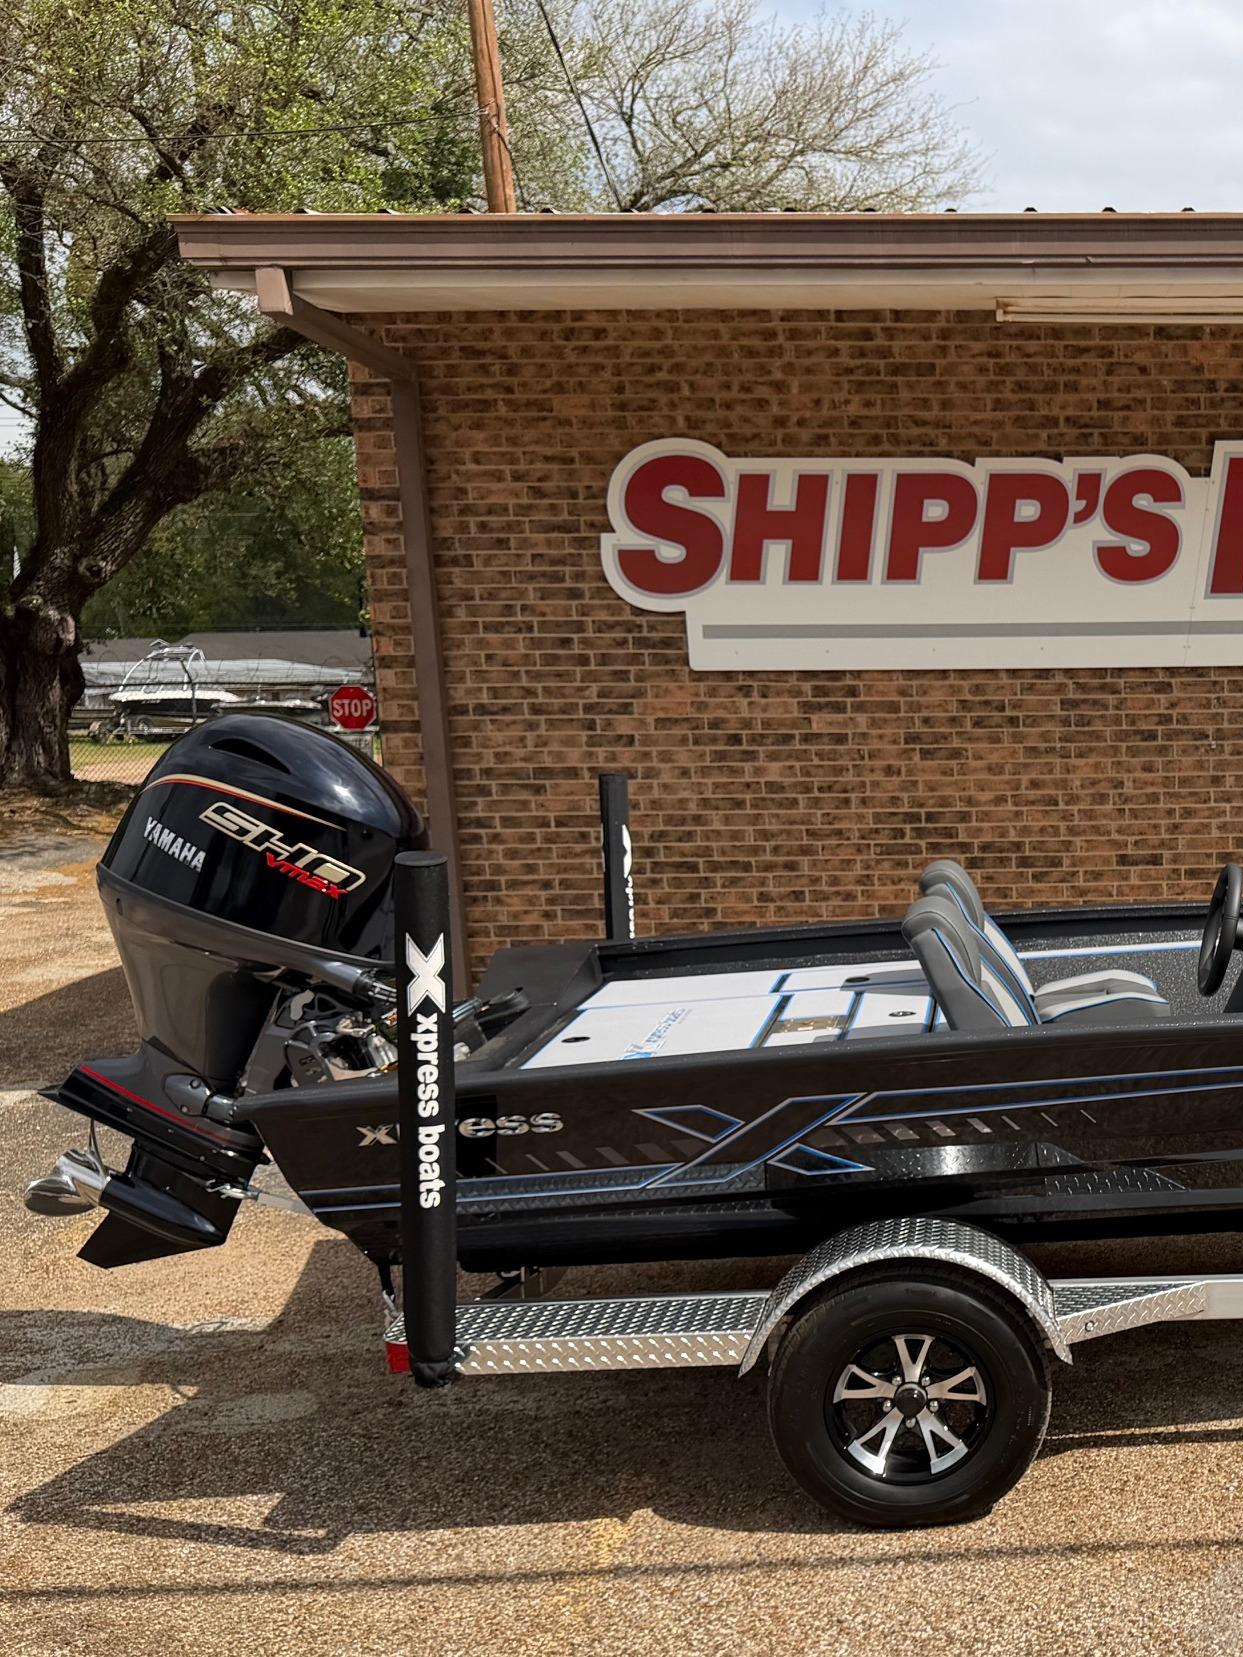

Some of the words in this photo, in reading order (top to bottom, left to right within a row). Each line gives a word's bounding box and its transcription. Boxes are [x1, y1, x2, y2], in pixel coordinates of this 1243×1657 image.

[613, 451, 1186, 597] SHIPP'S
[332, 698, 372, 718] STOP
[143, 817, 208, 873] YAMAHA
[410, 1012, 439, 1118] xpress
[355, 1112, 565, 1147] xess
[418, 1124, 446, 1209] boats
